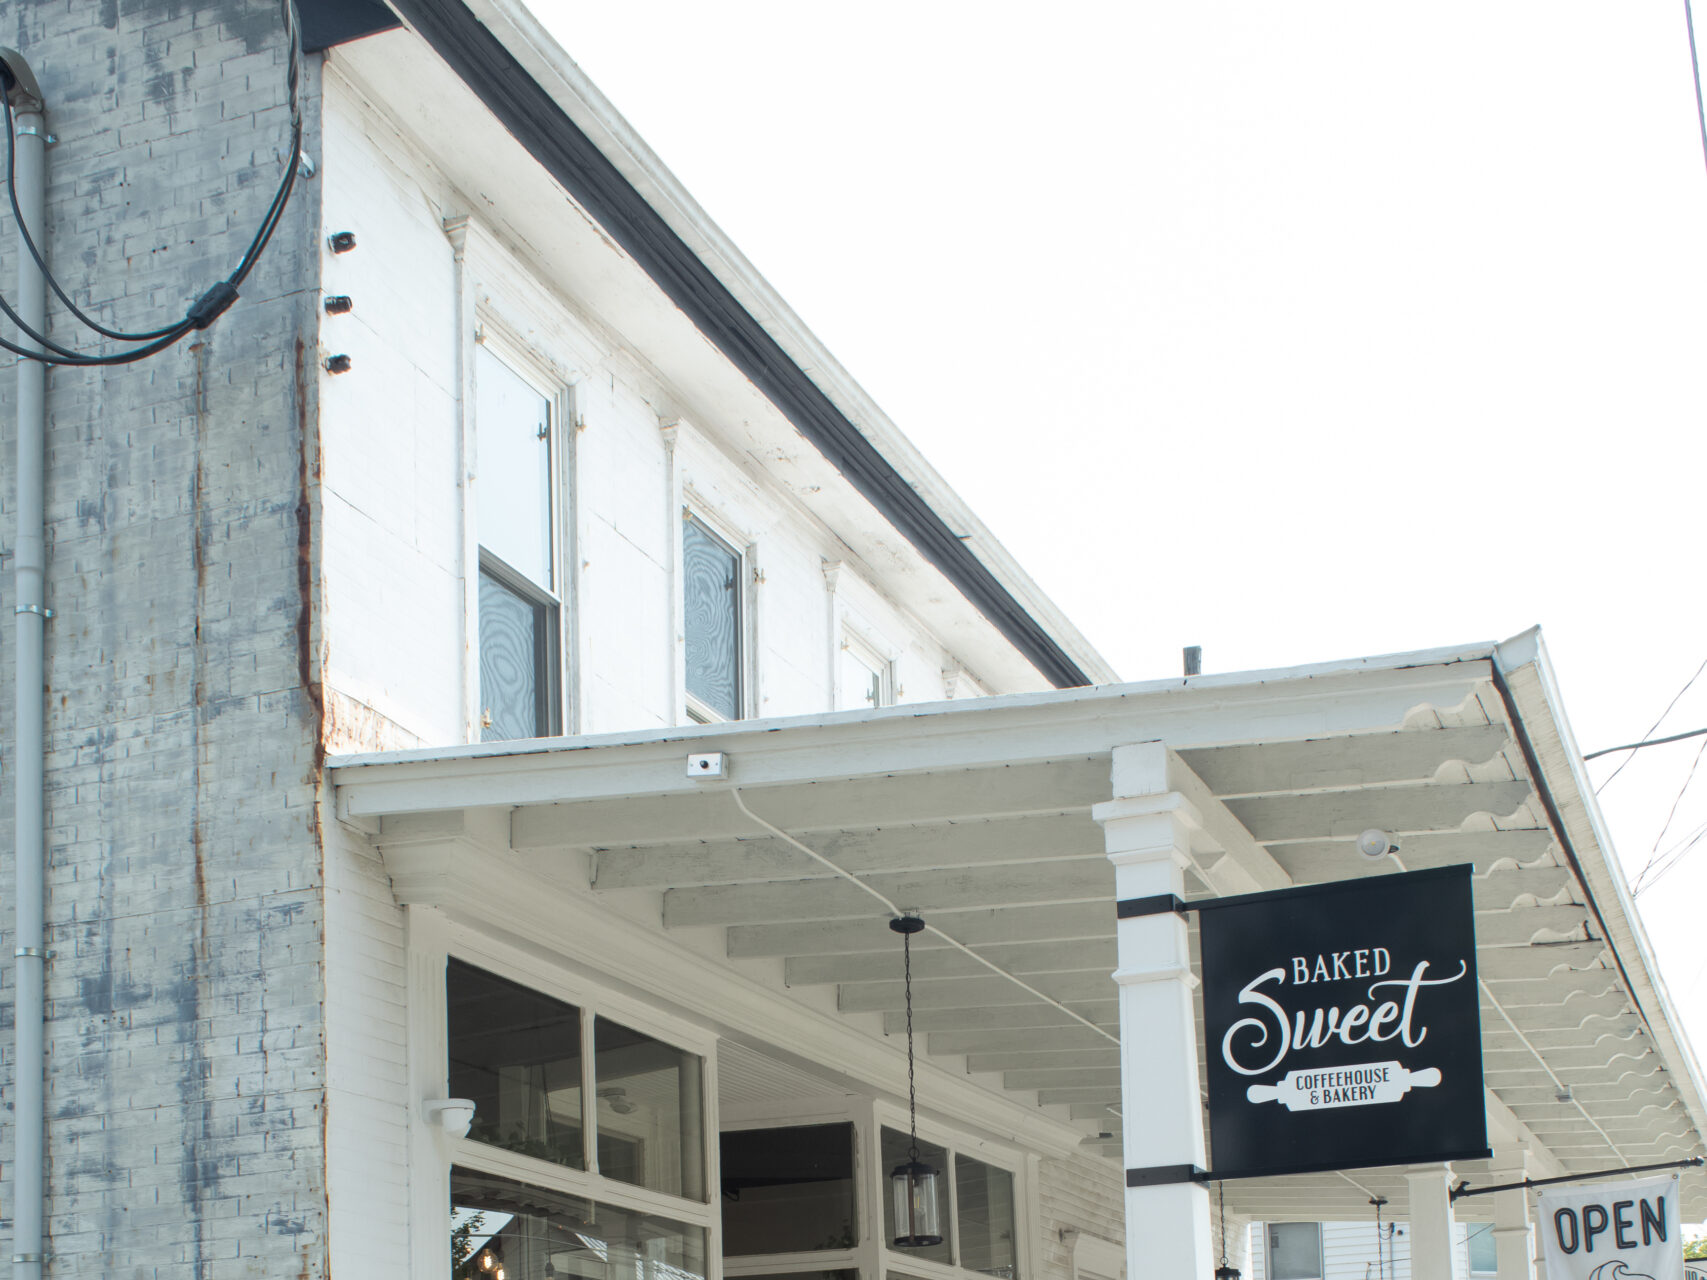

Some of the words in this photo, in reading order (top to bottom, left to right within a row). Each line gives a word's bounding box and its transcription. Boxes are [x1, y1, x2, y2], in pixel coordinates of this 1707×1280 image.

[1291, 947, 1391, 985] BAKED
[1222, 959, 1467, 1076] Sweet
[1295, 1067, 1391, 1091] COFFEEHOUSE
[1310, 1090, 1320, 1105] &
[1322, 1084, 1377, 1104] BAKERY
[1553, 1196, 1667, 1255] OPEN
